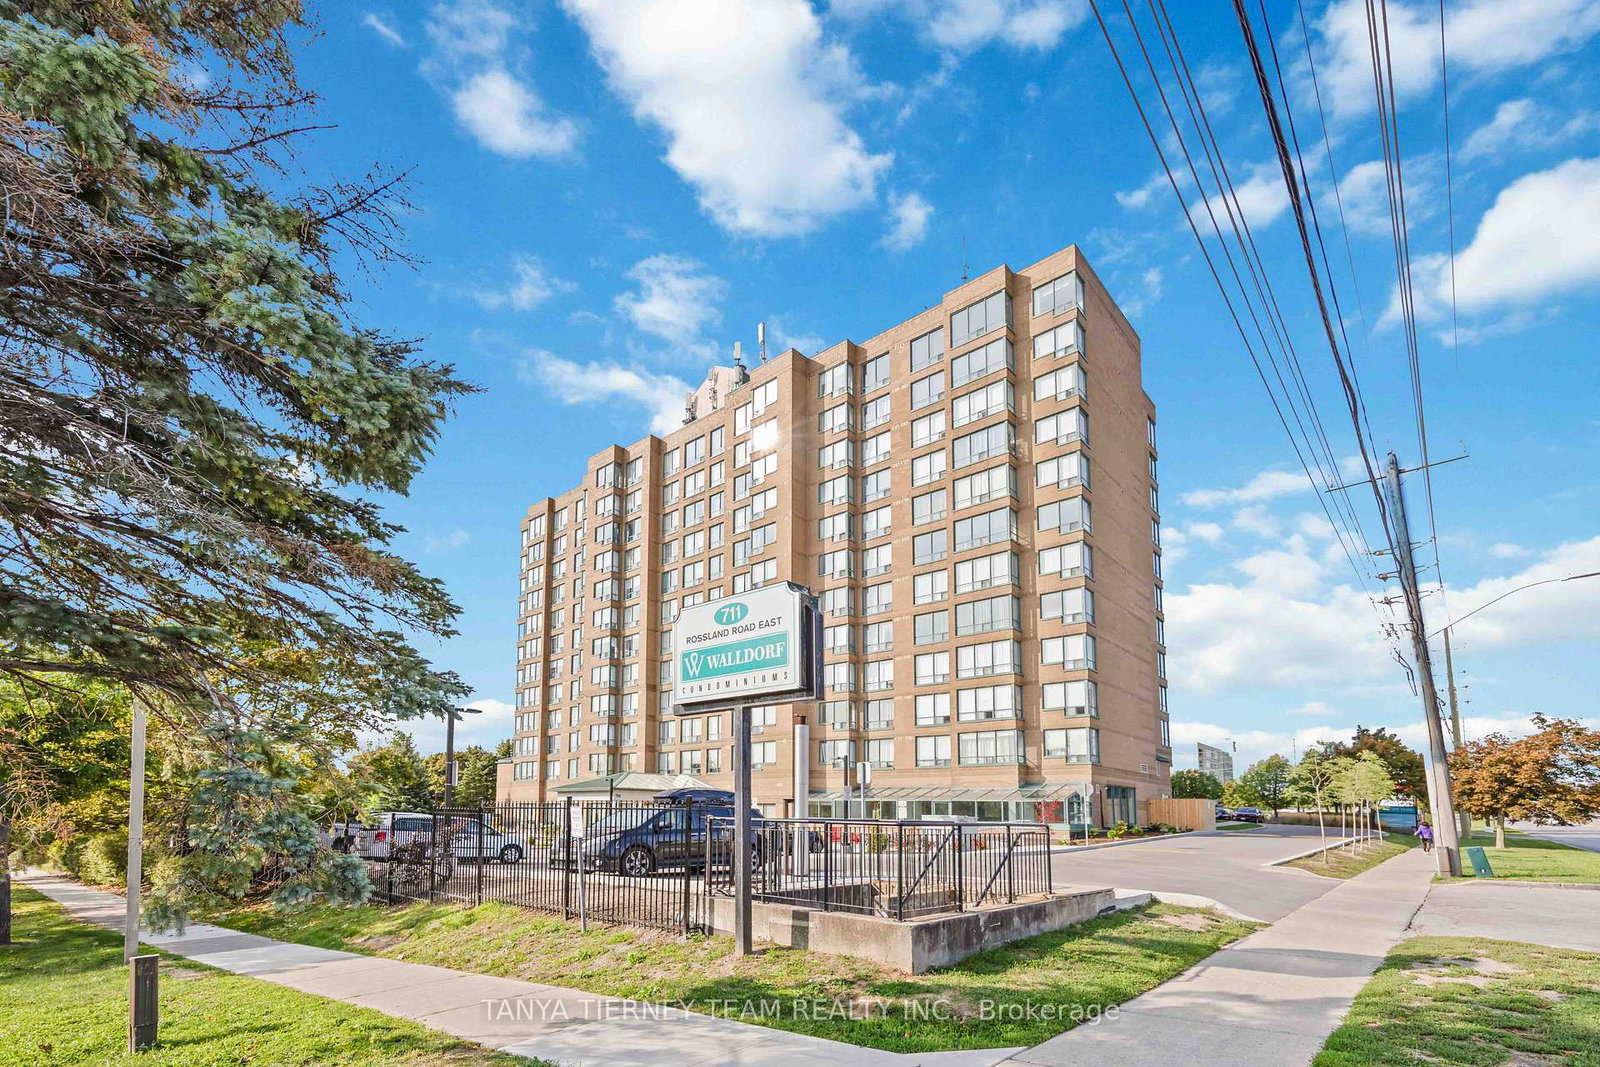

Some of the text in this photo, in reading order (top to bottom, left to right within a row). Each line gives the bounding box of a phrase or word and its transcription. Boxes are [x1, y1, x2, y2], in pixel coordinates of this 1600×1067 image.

[720, 605, 742, 623] 711
[686, 616, 782, 645] ROSSLAND ROAD EAST
[706, 641, 785, 670] WALLDORF
[682, 671, 789, 695] CONDOMINIUMS
